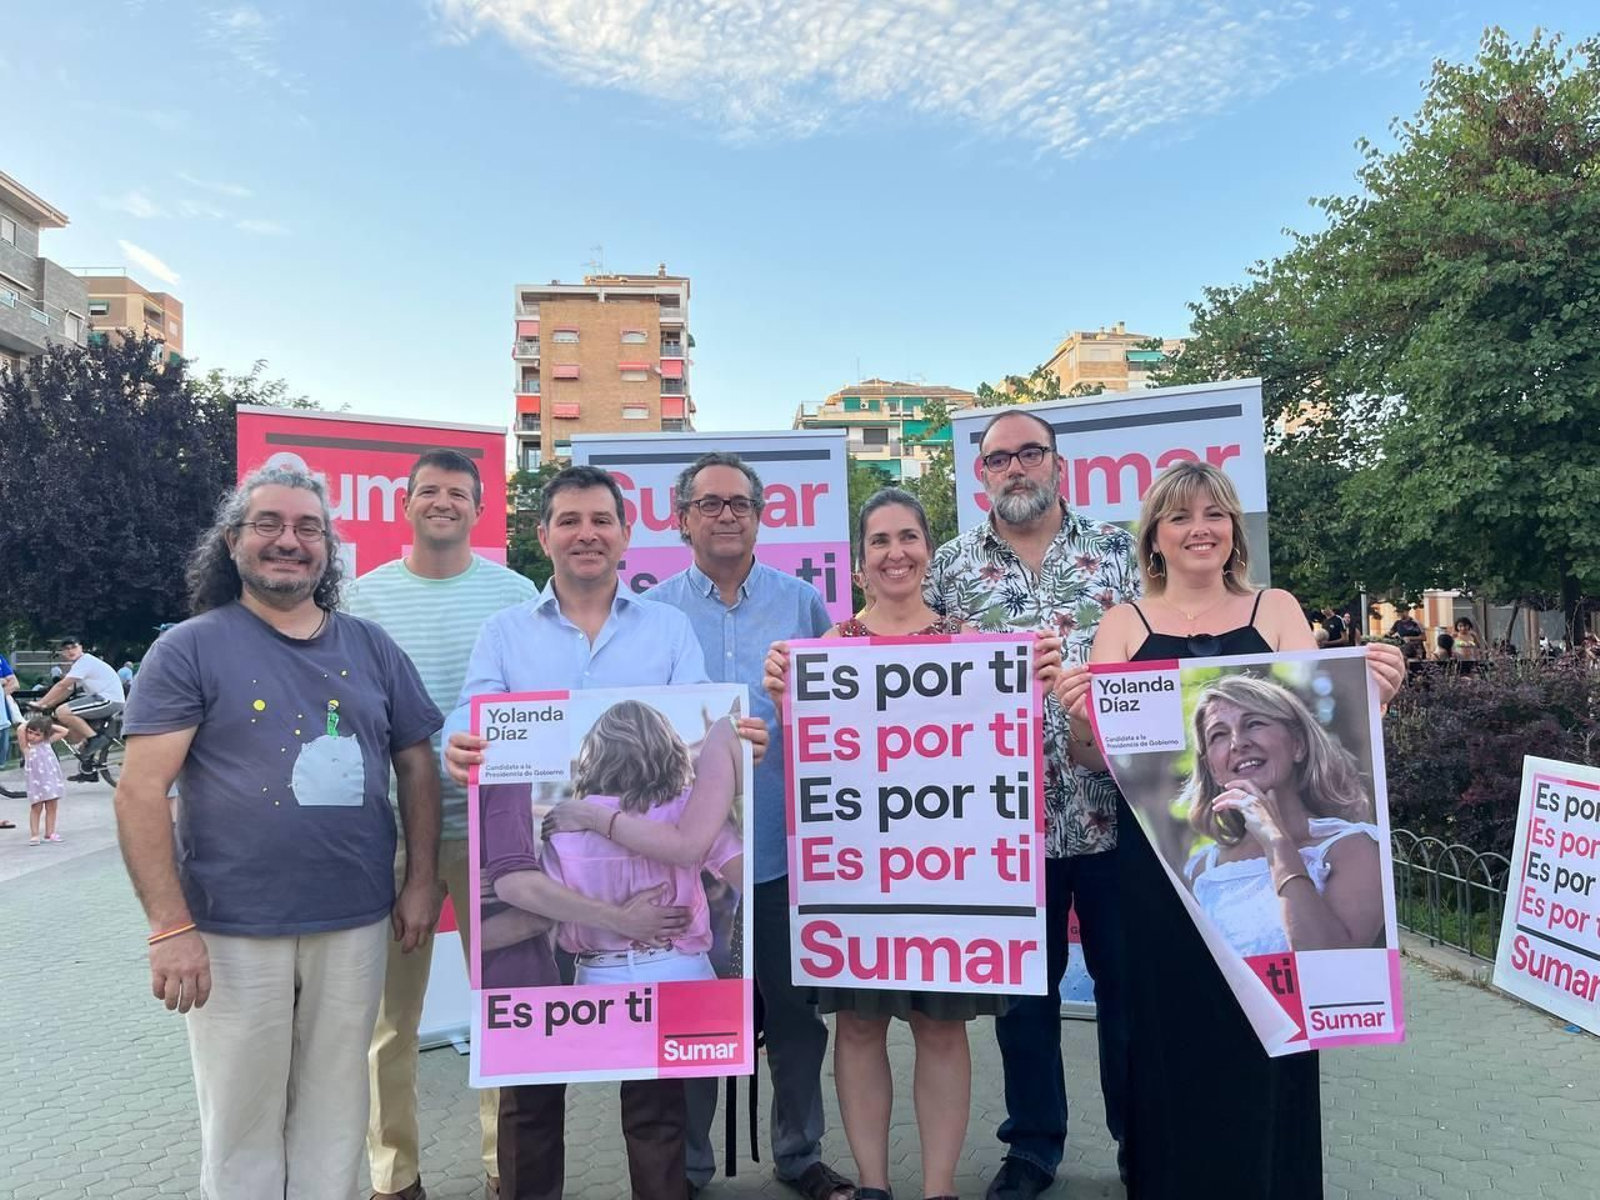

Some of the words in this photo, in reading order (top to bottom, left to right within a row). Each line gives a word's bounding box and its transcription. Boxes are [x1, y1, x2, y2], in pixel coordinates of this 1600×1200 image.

[796, 653, 860, 701] Es
[876, 661, 973, 711] por
[989, 646, 1028, 693] ti
[1098, 676, 1174, 695] Yolanda
[488, 705, 563, 723] Yolanda
[1100, 697, 1140, 713] Díaz
[486, 725, 527, 741] Díaz
[798, 716, 861, 762] Es
[877, 723, 973, 772] por
[989, 708, 1028, 757] ti
[800, 777, 862, 822] Es
[878, 784, 974, 832] por
[990, 771, 1029, 819] ti
[1536, 782, 1560, 812] Es
[1532, 817, 1555, 848] Es
[1559, 831, 1600, 859] por
[802, 836, 864, 881] Es
[880, 846, 976, 893] por
[991, 834, 1030, 881] ti
[1527, 851, 1550, 882] Es
[1554, 866, 1596, 896] por
[1522, 886, 1545, 918] Es
[1548, 902, 1590, 933] por
[799, 919, 1038, 985] Sumar
[1511, 935, 1600, 1002] Sumar
[1266, 958, 1294, 995] ti
[488, 994, 533, 1029] Es
[545, 1000, 614, 1036] por
[625, 987, 652, 1022] ti
[1311, 1010, 1386, 1031] Sumar
[664, 1039, 738, 1061] Sumar
